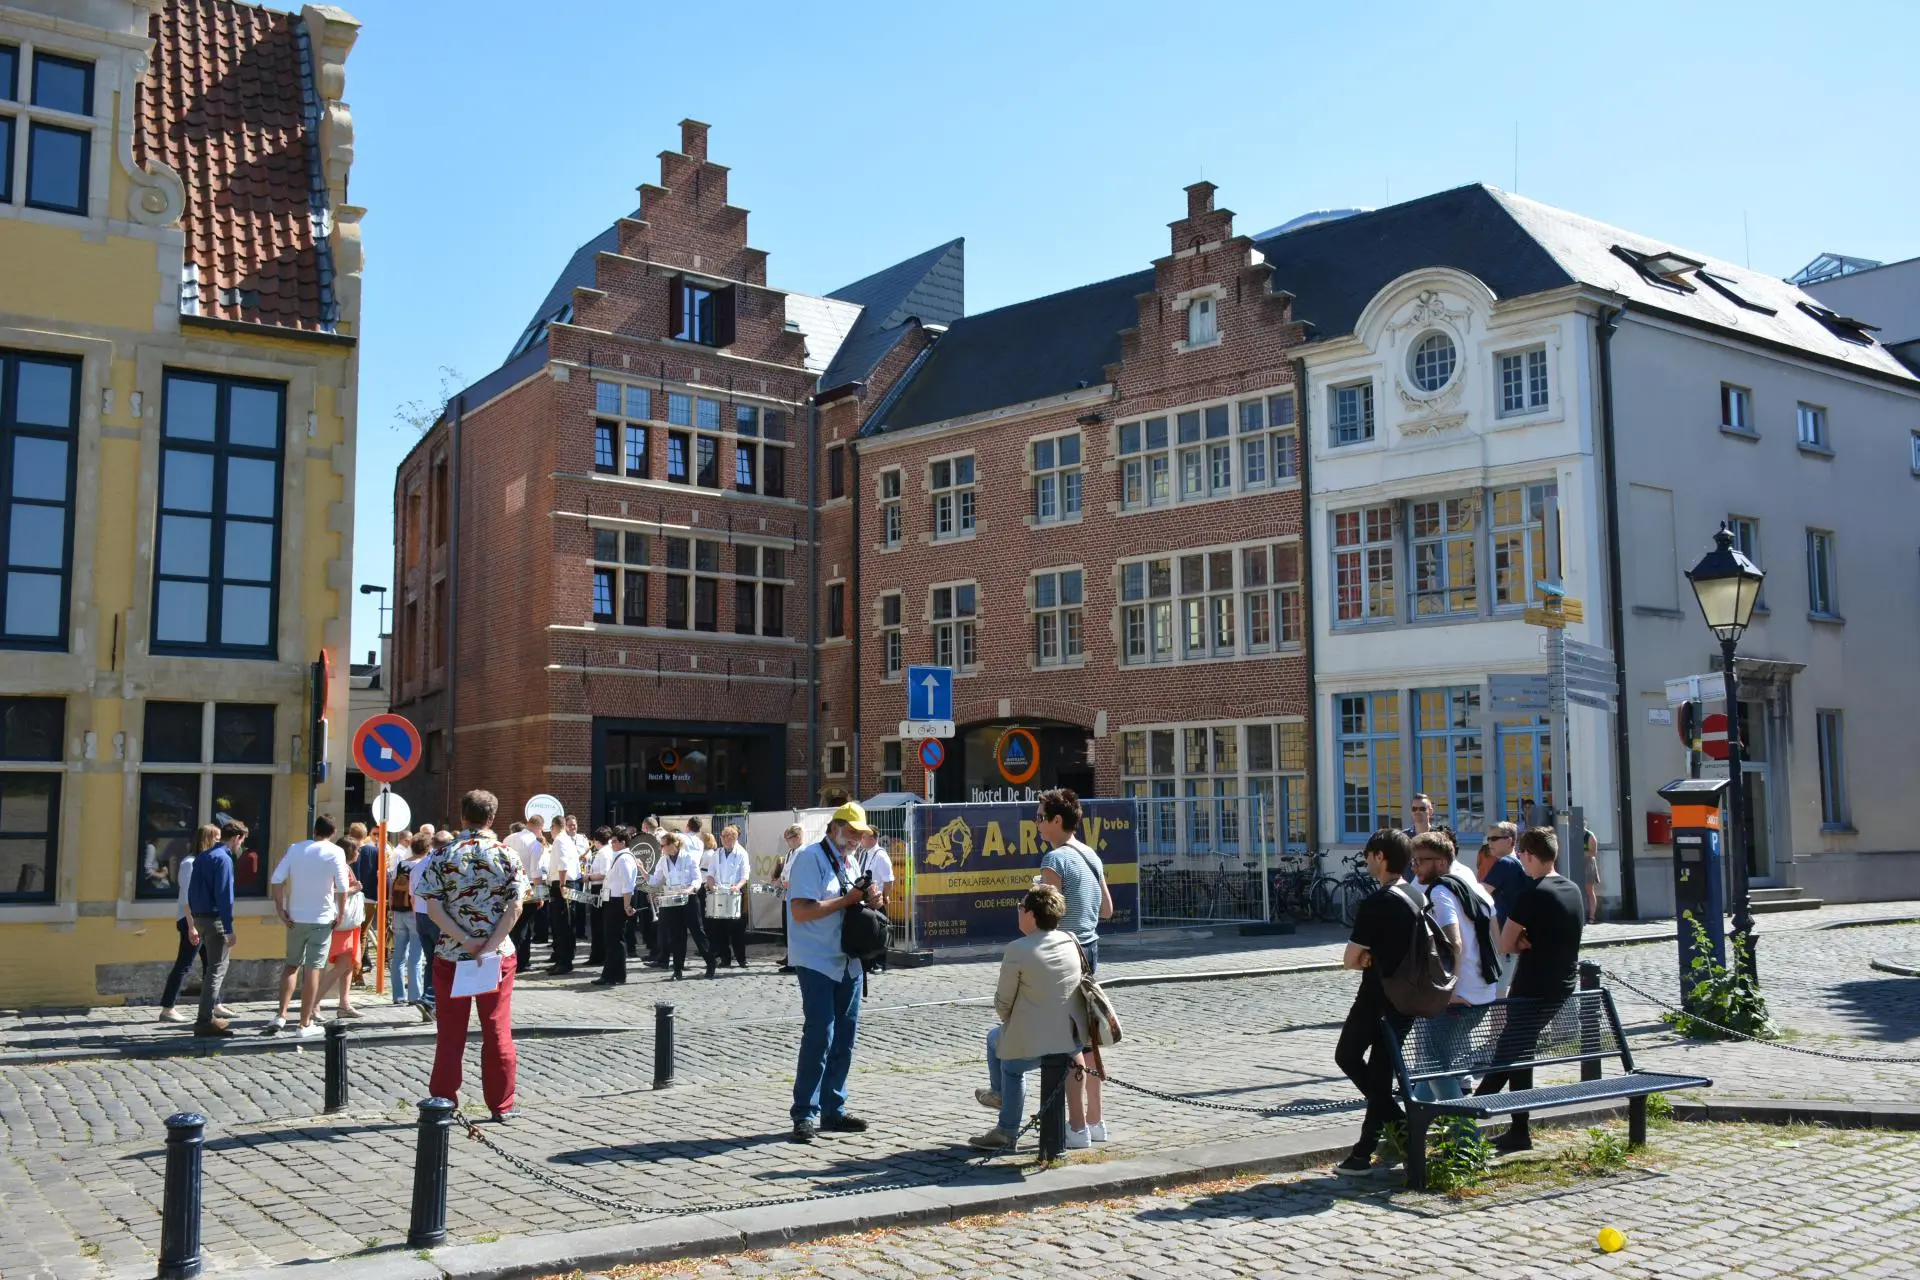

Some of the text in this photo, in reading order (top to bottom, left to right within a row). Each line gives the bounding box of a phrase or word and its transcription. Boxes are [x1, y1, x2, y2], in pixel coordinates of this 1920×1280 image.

[972, 787, 1001, 802] Hostel
[1008, 787, 1019, 801] De
[1103, 818, 1130, 830] bvba
[974, 898, 995, 909] OUDE
